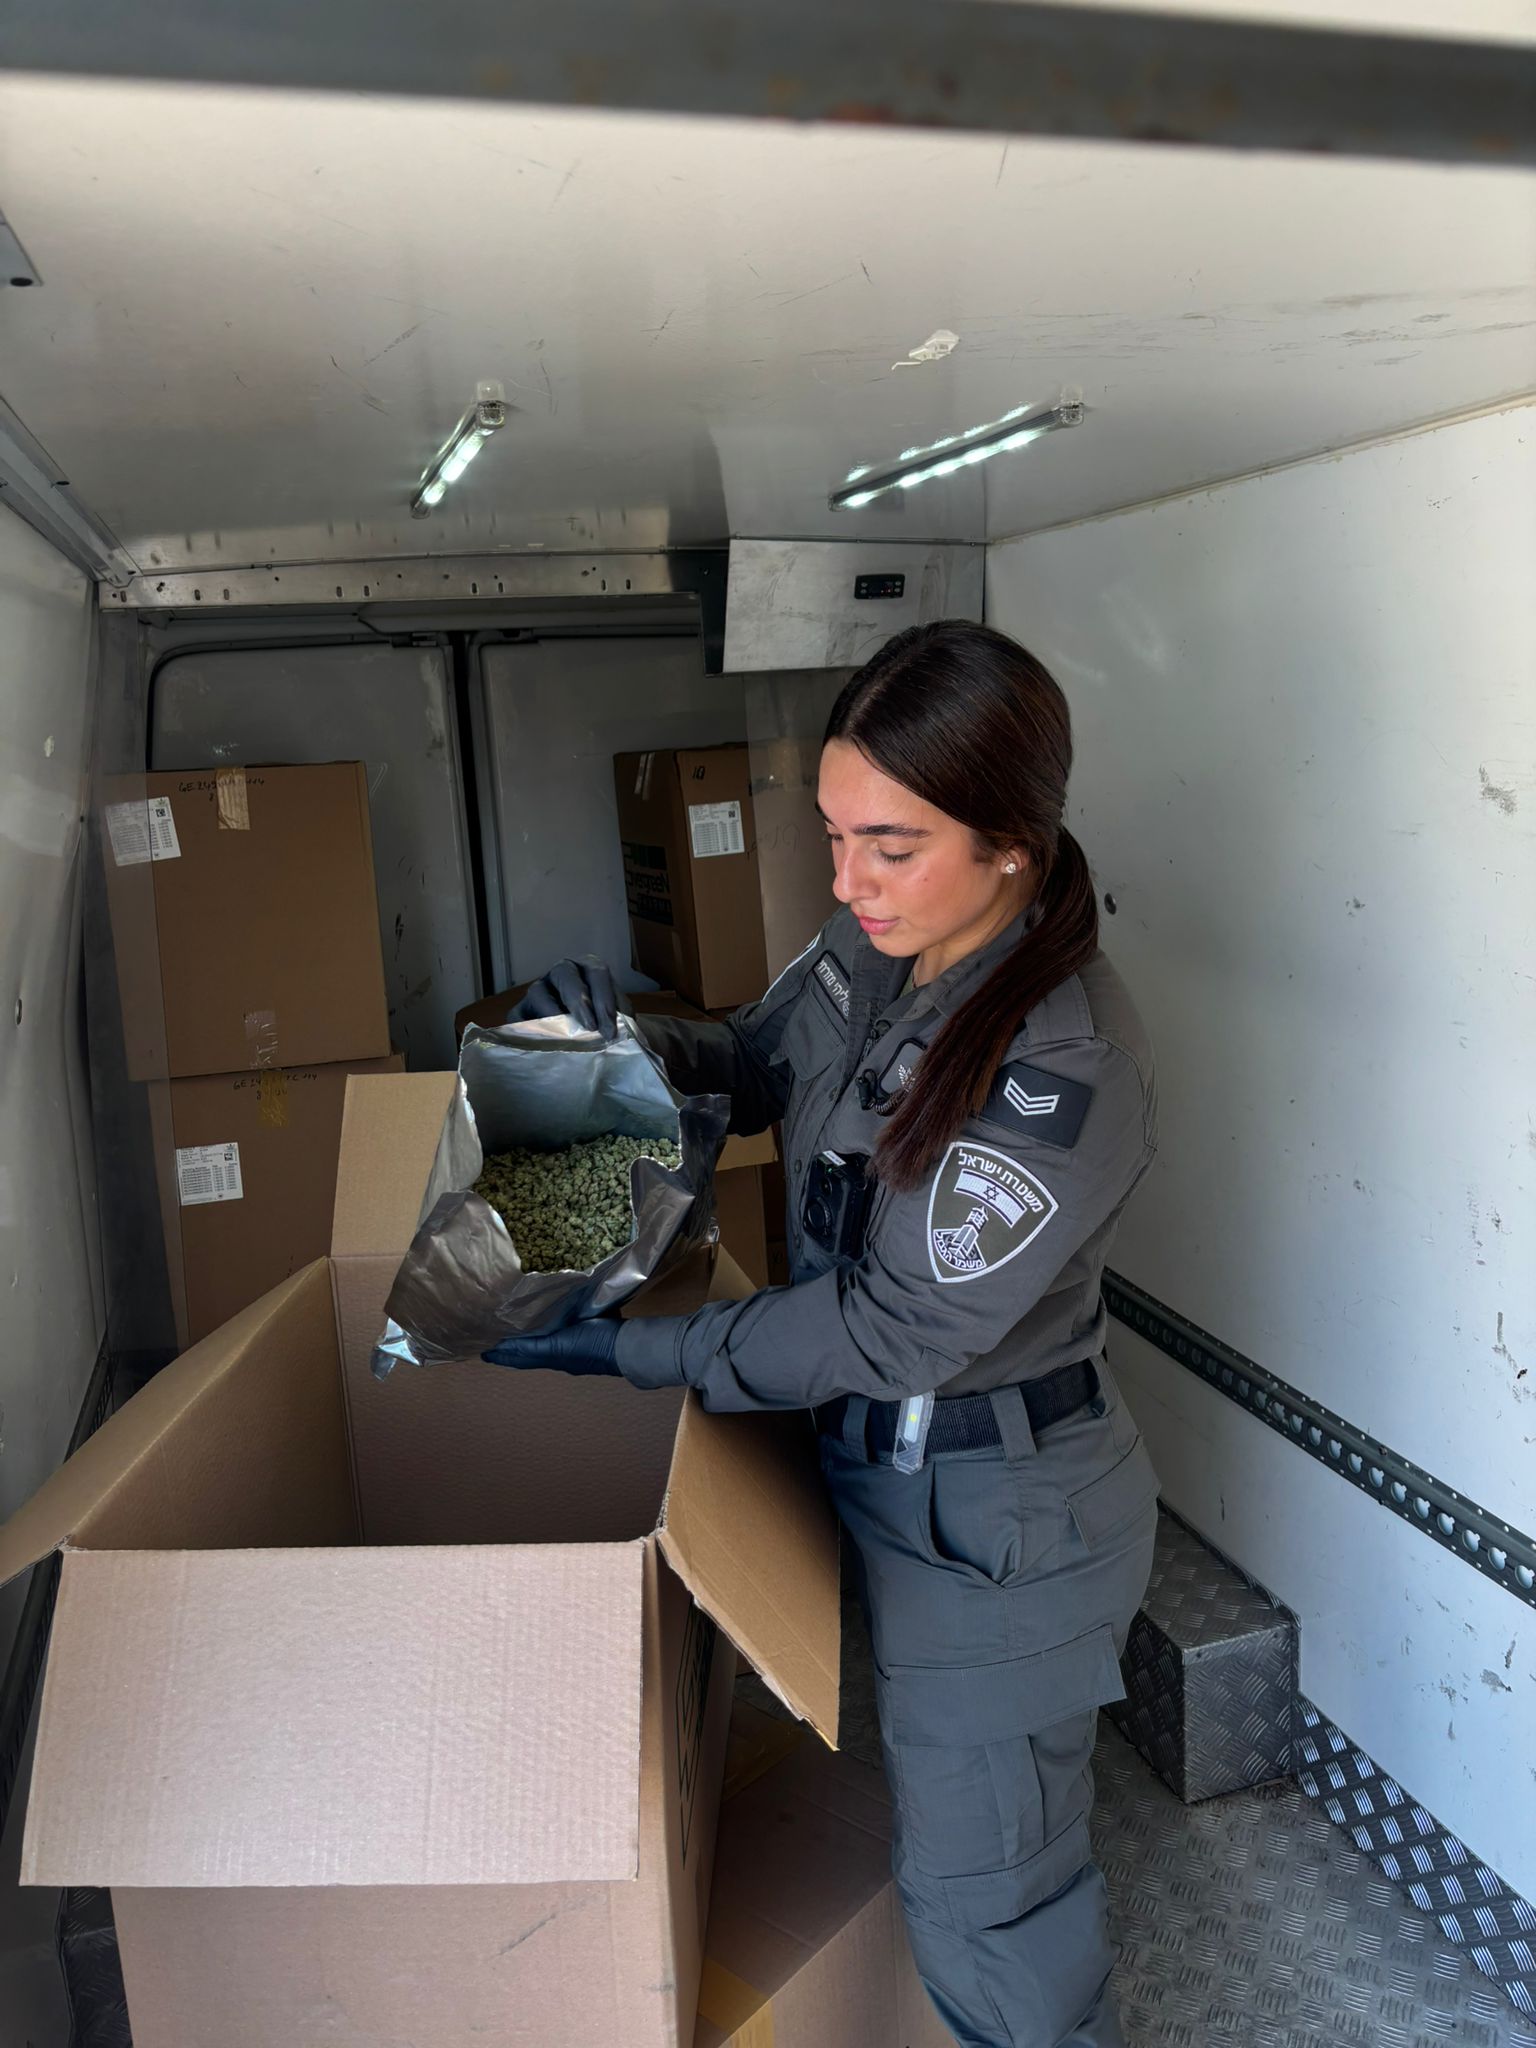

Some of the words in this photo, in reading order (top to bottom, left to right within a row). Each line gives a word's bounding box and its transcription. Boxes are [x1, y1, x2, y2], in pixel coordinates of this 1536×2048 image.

[818, 960, 837, 986] מזרחי
[832, 982, 849, 1002] ליהי
[957, 1148, 1003, 1175] ישראל
[999, 1170, 1045, 1213] משטרת
[953, 1256, 984, 1268] משמר
